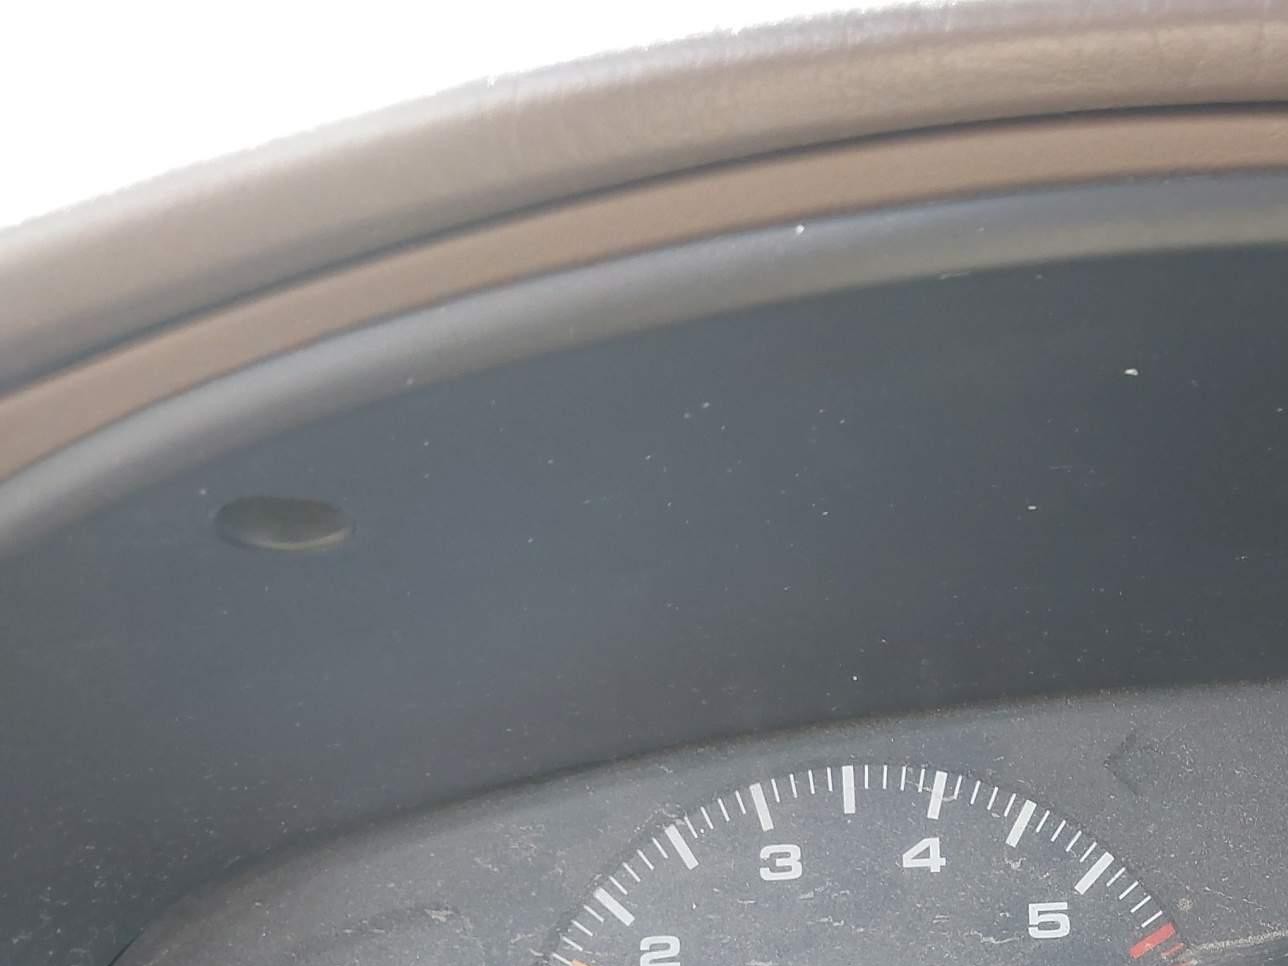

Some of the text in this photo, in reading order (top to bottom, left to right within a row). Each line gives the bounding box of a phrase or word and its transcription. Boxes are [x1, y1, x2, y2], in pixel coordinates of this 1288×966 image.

[759, 844, 802, 881] 3
[902, 837, 946, 873] 4
[1027, 901, 1071, 939] 5
